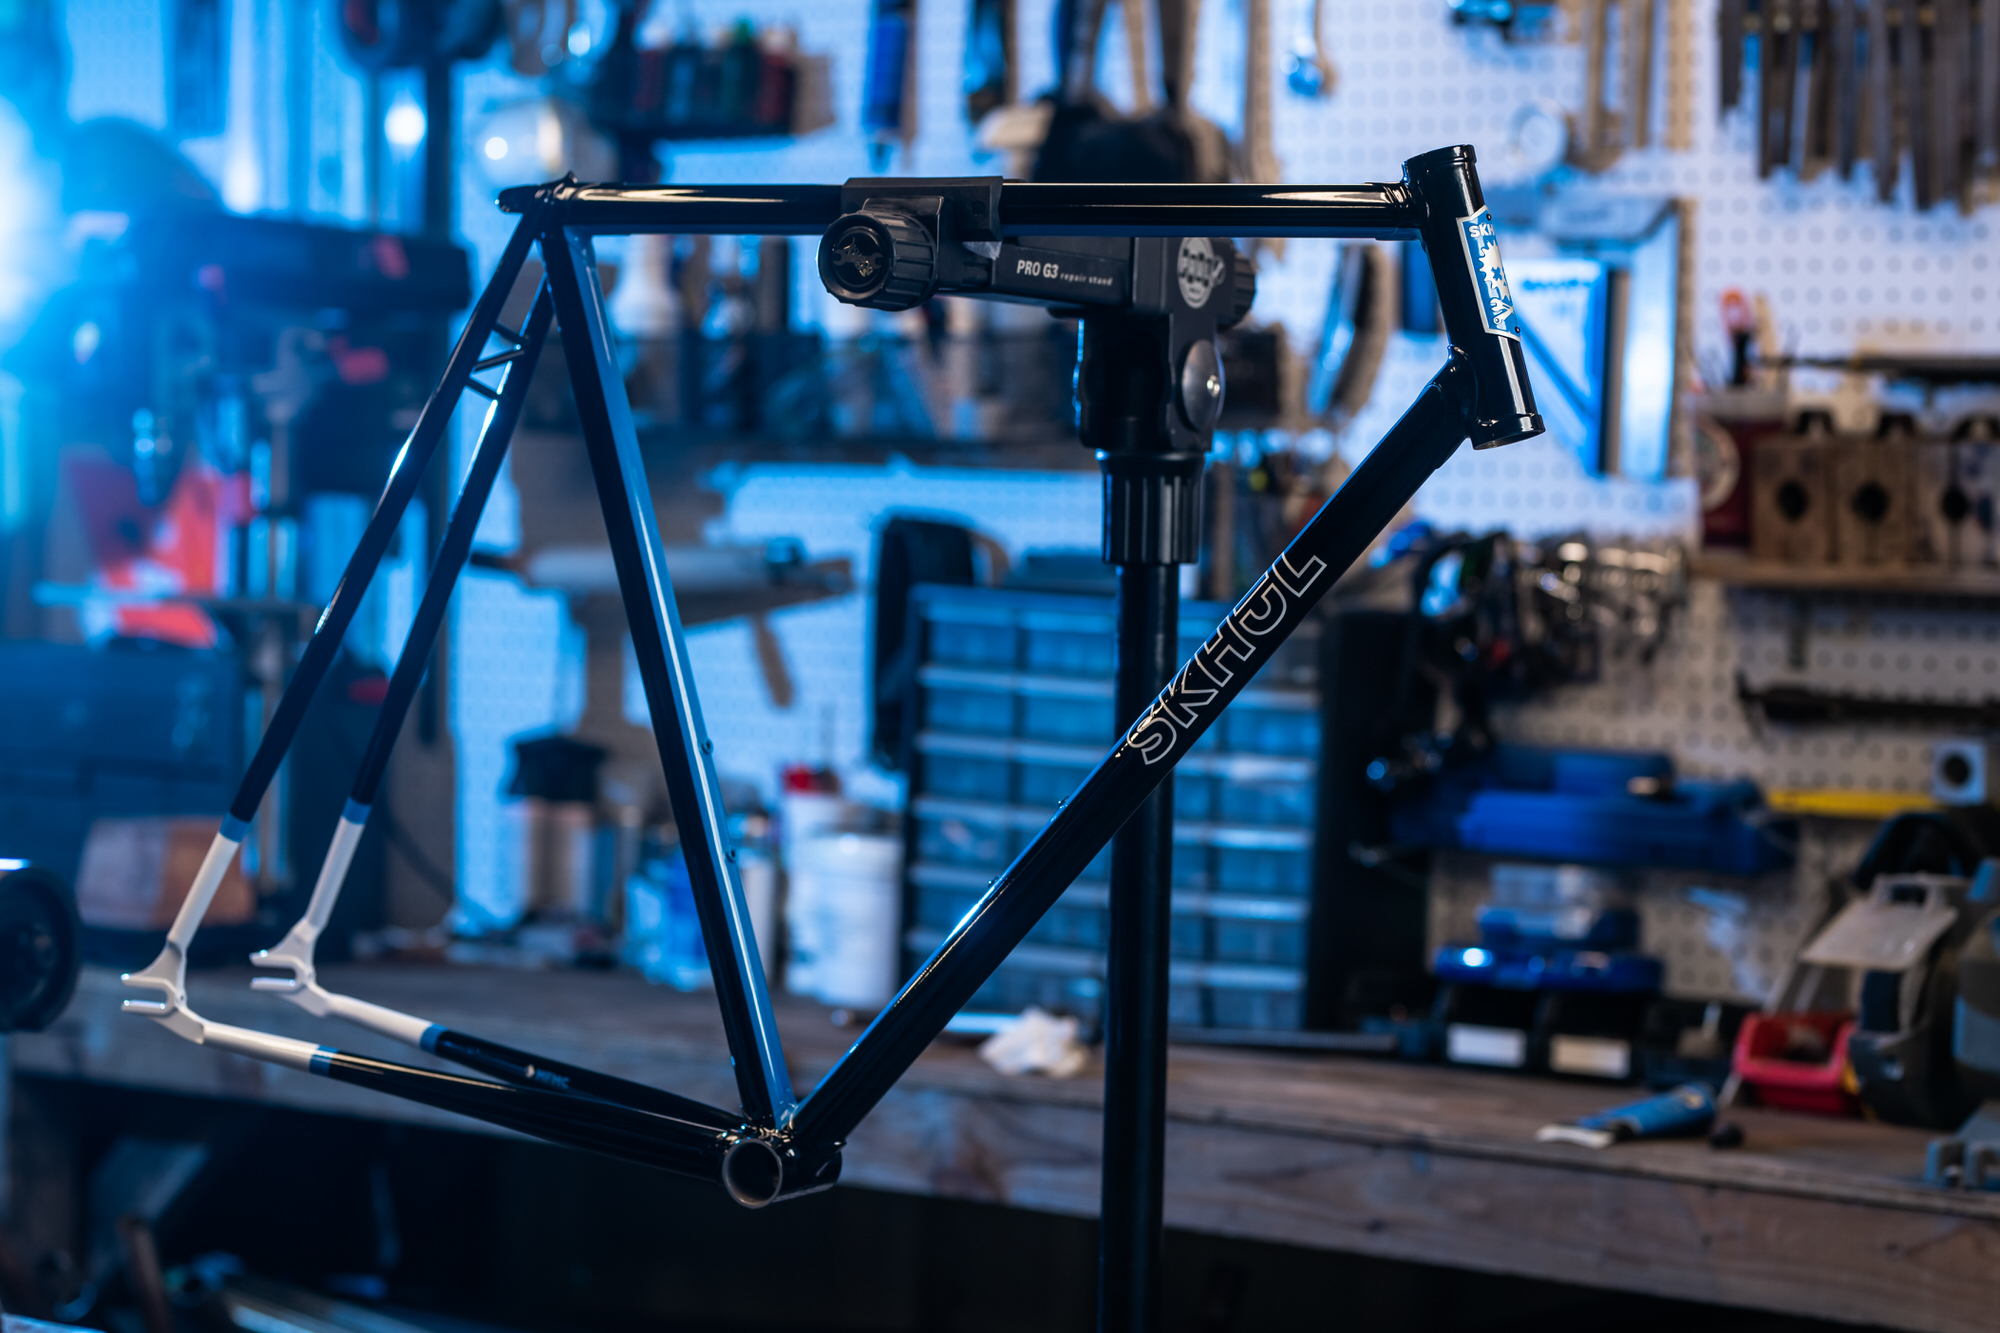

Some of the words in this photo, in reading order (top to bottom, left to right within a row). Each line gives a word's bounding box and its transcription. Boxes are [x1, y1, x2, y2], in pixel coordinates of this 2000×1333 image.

[1468, 223, 1495, 238] SKH
[1016, 259, 1041, 276] PRO
[1043, 263, 1059, 279] G3
[1060, 273, 1087, 283] repair
[1088, 276, 1114, 286] stand
